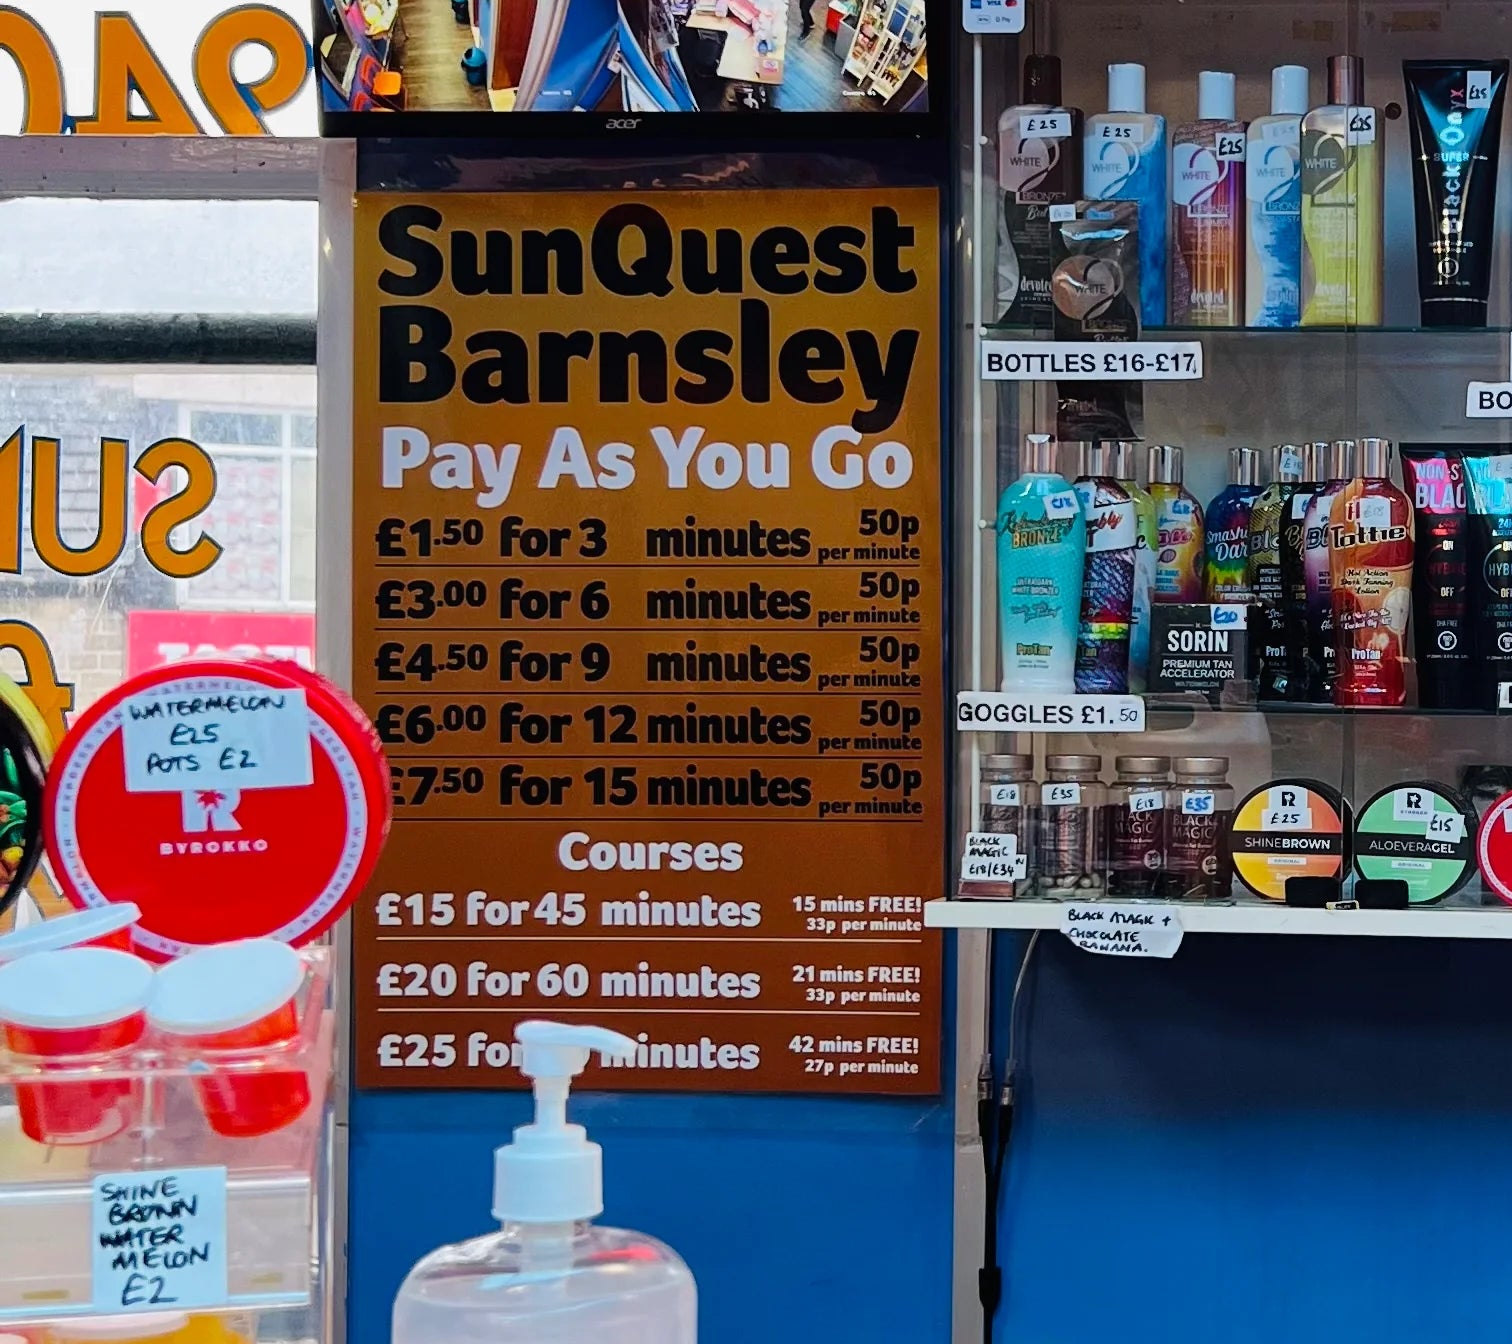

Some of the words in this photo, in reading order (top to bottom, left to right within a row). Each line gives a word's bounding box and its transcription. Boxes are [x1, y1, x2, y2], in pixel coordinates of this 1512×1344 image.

[606, 118, 642, 129] acer
[1026, 118, 1058, 131] £25
[1009, 156, 1042, 168] WHITE
[378, 203, 918, 298] SunQuest
[378, 299, 920, 434] Barnsley
[987, 354, 1096, 373] BOTTLES
[1103, 352, 1194, 372] £16-£17
[382, 426, 521, 508] Pay
[538, 427, 635, 489] As
[650, 426, 790, 489] You
[811, 426, 913, 489] Go
[375, 517, 484, 557] £1.50
[500, 516, 571, 557] for
[580, 518, 607, 557] 3
[646, 515, 811, 557] minutes
[859, 509, 920, 542] 50p
[817, 545, 850, 564] per
[853, 542, 921, 561] minute
[375, 580, 487, 620] £3.00
[500, 578, 571, 619] for
[580, 580, 610, 619] 6
[646, 577, 811, 620] minutes
[1167, 630, 1228, 652] SORIN
[1160, 669, 1235, 679] ACCELERATOR
[1163, 660, 1209, 670] PREMIUM
[1212, 660, 1233, 670] TAN
[129, 693, 287, 721] WATERMELON
[959, 704, 1074, 724] GOGGLES
[146, 752, 202, 775] POTS
[219, 749, 257, 770] £2
[1271, 813, 1300, 825] £25
[159, 839, 268, 855] BYROKKO
[557, 831, 744, 872] Courses
[1244, 836, 1331, 850] SHINEBROWN
[1369, 839, 1455, 854] ALOEVERAGEL
[376, 892, 455, 927] £15
[467, 891, 529, 926] for
[534, 893, 586, 926] 45
[601, 891, 762, 927] minutes
[792, 896, 817, 913] 15
[820, 896, 865, 913] mins
[868, 896, 922, 913] FREE!
[1069, 908, 1104, 921] BLACK
[806, 918, 836, 934] 33p
[841, 920, 866, 934] per
[869, 917, 922, 932] minute
[100, 1175, 180, 1202] SHINE
[111, 1242, 210, 1270] MELON
